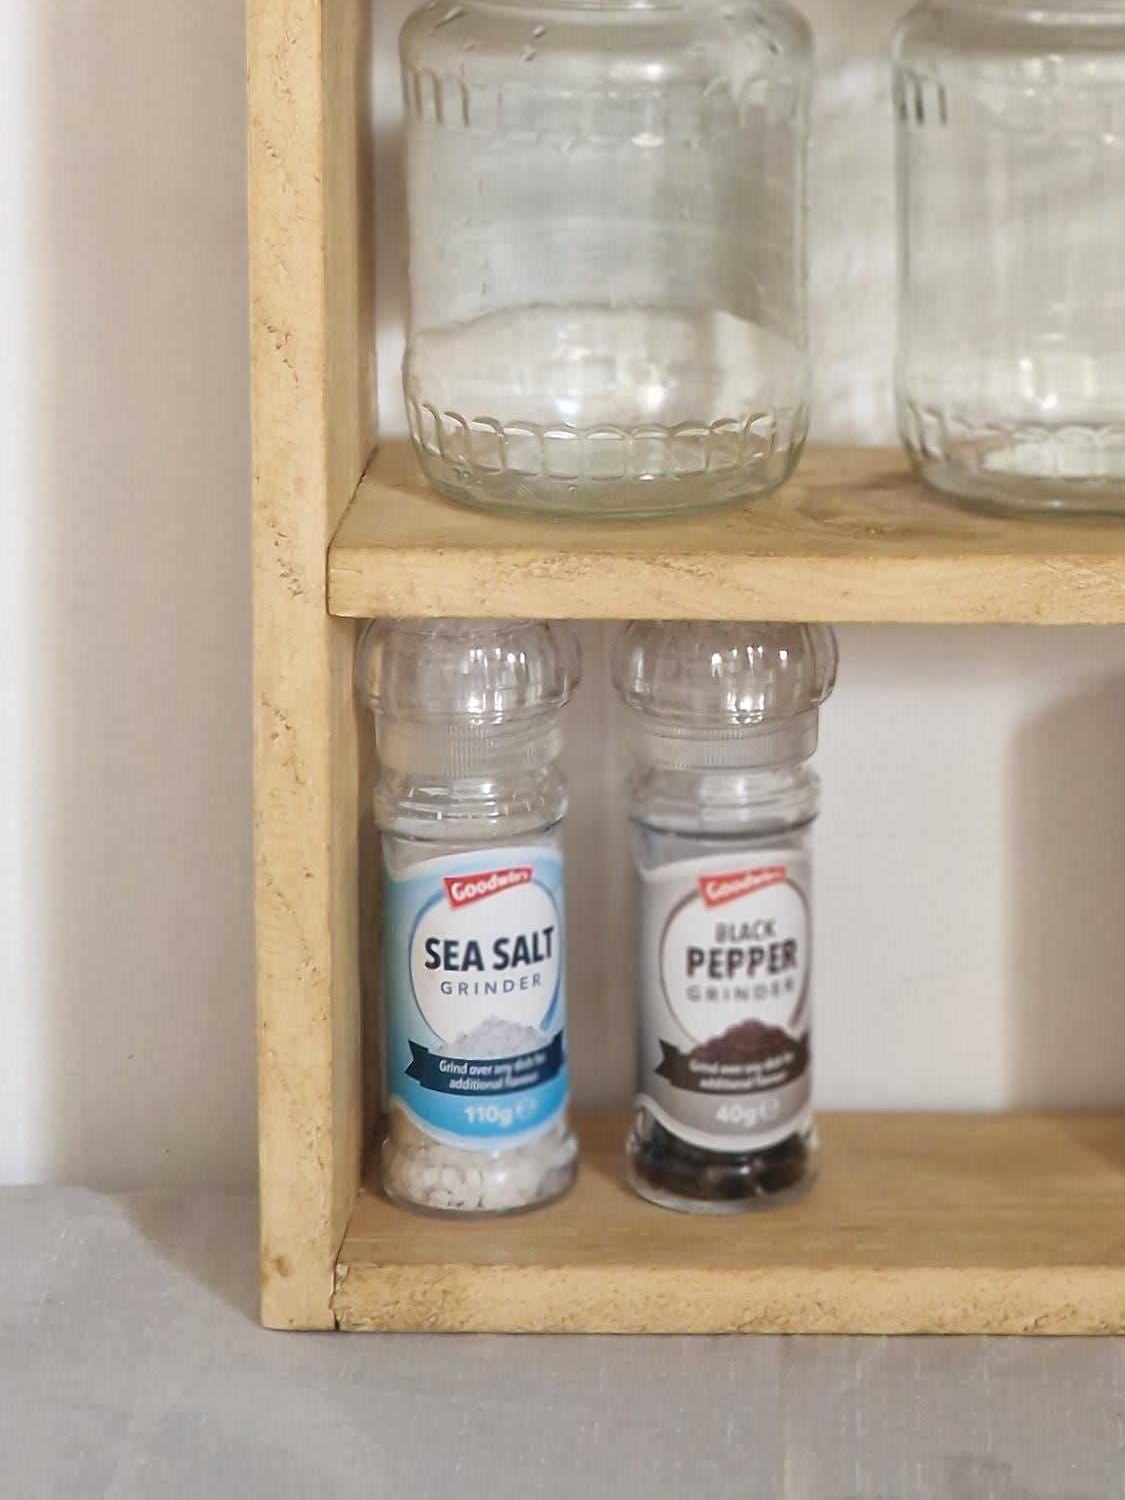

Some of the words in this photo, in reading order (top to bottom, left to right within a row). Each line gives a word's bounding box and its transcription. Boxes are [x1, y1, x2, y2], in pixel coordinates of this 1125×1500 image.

[714, 918, 777, 944] BLACK
[424, 937, 485, 972] SEA
[492, 924, 555, 971] SALT
[686, 938, 797, 980] PEPPER
[440, 973, 542, 996] GRINDER
[686, 977, 795, 1002] GRINDER
[439, 1060, 467, 1074] Grind
[469, 1065, 492, 1075] over
[450, 1077, 503, 1090] additional
[465, 1104, 513, 1127] 110g
[715, 1103, 757, 1128] 40g
